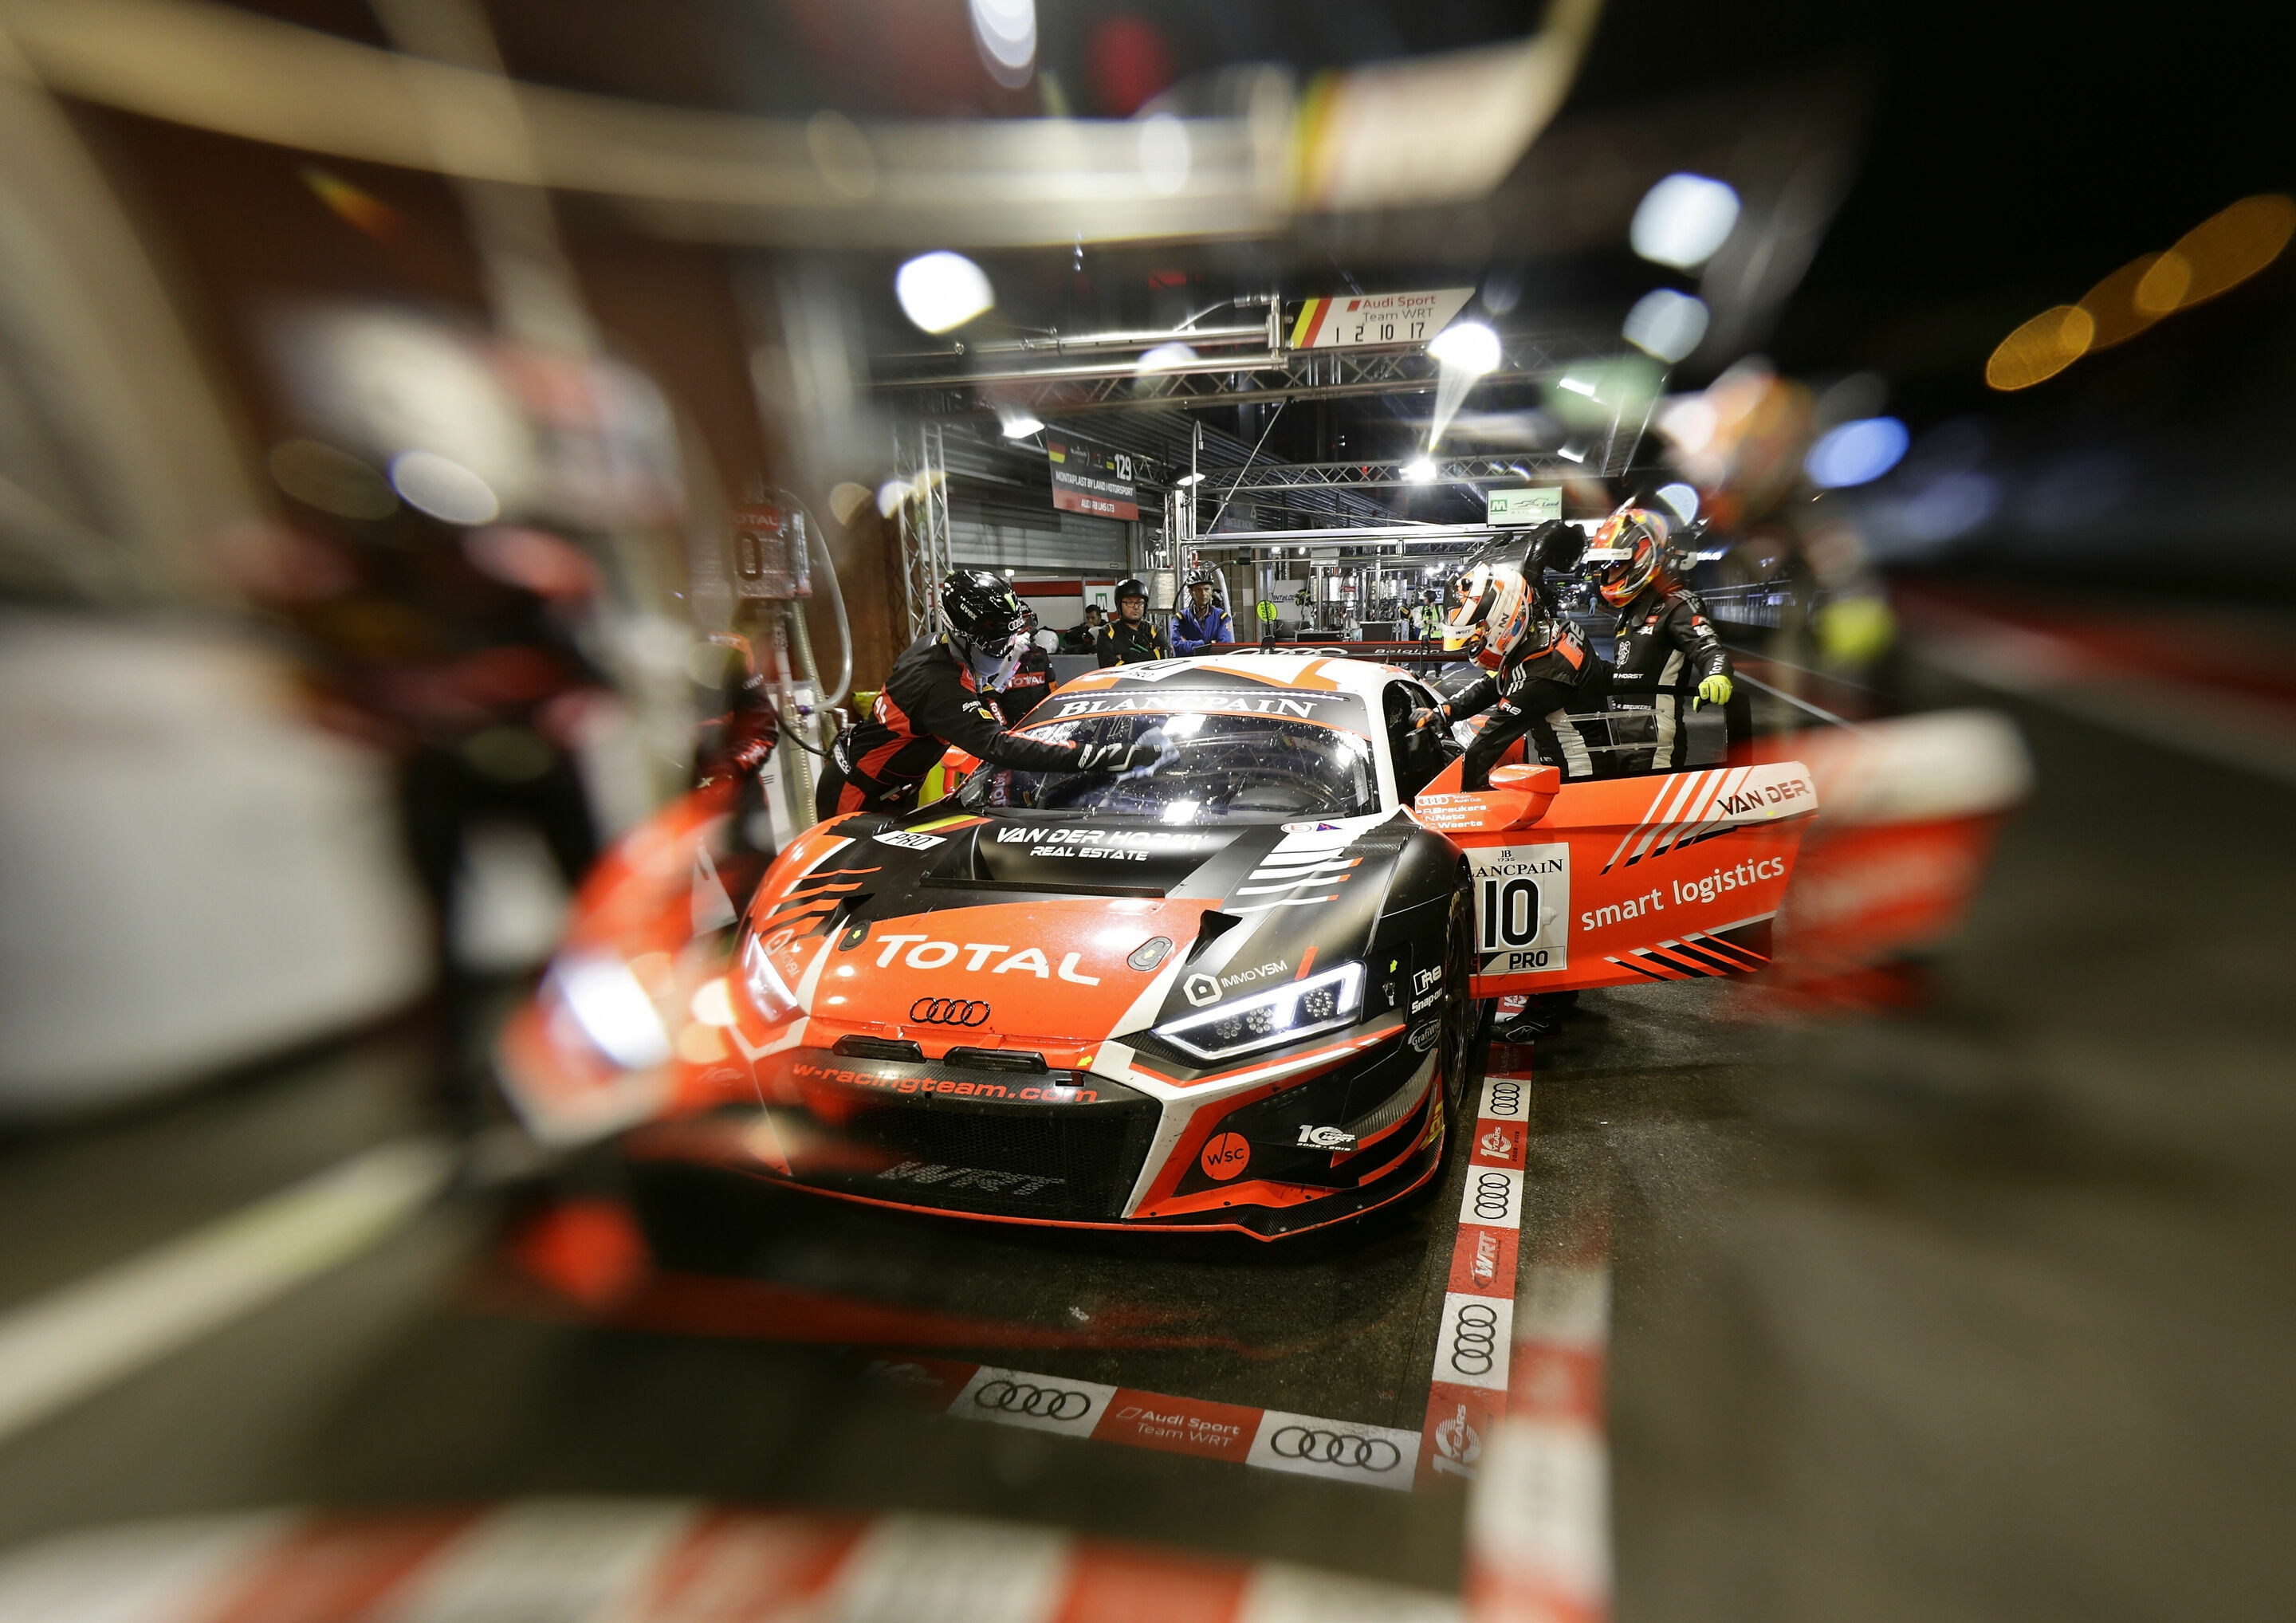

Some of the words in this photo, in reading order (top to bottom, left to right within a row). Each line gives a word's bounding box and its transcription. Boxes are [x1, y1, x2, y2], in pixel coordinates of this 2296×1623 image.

[1362, 297, 1394, 309] Audi
[1398, 295, 1436, 308] Sport
[1363, 312, 1398, 323] Team
[1402, 308, 1434, 319] WRT
[1335, 327, 1339, 344] 1
[1355, 324, 1364, 342] 2
[1380, 324, 1394, 340] 10
[1410, 322, 1425, 339] 17
[1115, 454, 1132, 481] 129
[1056, 470, 1087, 487] MONTAPLAST
[1087, 478, 1094, 488] BY
[1093, 480, 1106, 492] LAND
[1081, 499, 1091, 509] AUDI
[729, 512, 778, 526] OTAL
[960, 603, 977, 621] uvex
[1709, 654, 1726, 675] TOTAL
[1054, 696, 1318, 718] BLANCPAIN
[1500, 702, 1522, 716] R8
[1718, 790, 1764, 816] VAN
[1768, 779, 1811, 804] DER
[889, 831, 931, 848] PRO
[997, 827, 1044, 844] VAN
[1044, 829, 1107, 846] DER
[1111, 830, 1211, 851] HORST
[1029, 846, 1078, 859] REAL
[1079, 847, 1150, 862] ESTATE
[1472, 859, 1563, 878] ANCPAIN
[1581, 886, 1665, 932] smart
[1673, 855, 1786, 907] logistics
[1483, 877, 1540, 949] 10
[875, 934, 1101, 987] TOTAL
[1509, 950, 1548, 969] PRO
[1421, 965, 1442, 988] R8
[1411, 987, 1443, 1015] Snap-on
[793, 1063, 1099, 1103] w-racingteam.com
[1298, 1124, 1343, 1146] 10
[1480, 1132, 1512, 1160] 10
[1492, 1126, 1502, 1151] YEARS
[1475, 1230, 1498, 1279] WRT
[1142, 1410, 1184, 1427] Audi
[1189, 1417, 1240, 1436] Sport
[1450, 1403, 1466, 1460] YEARS
[1138, 1423, 1183, 1440] Team
[1189, 1432, 1234, 1448] WRT
